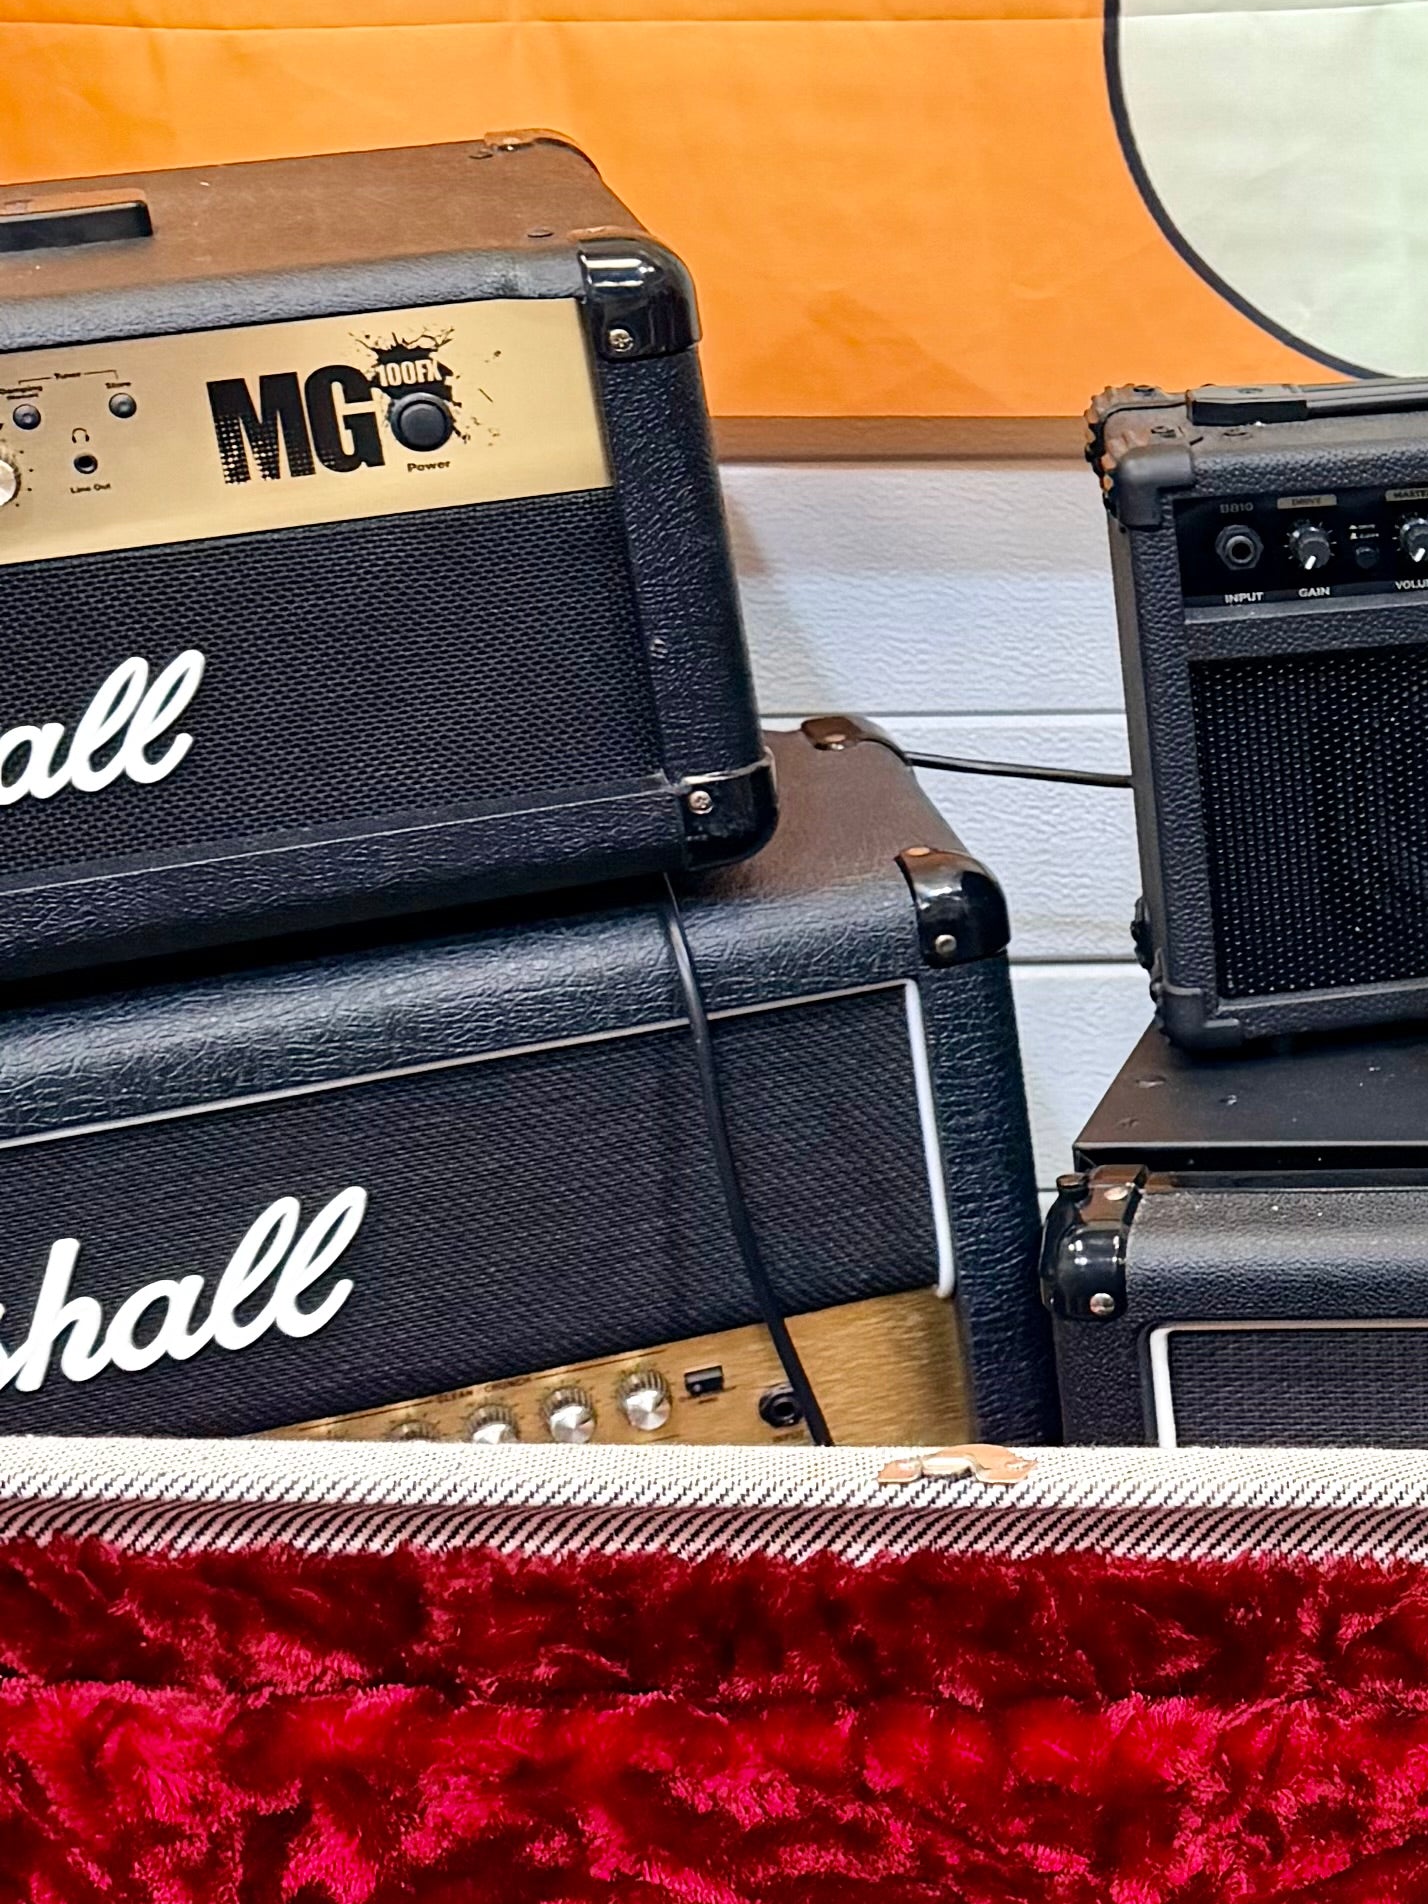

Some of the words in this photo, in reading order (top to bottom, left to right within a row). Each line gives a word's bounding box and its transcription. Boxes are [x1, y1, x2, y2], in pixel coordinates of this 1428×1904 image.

[376, 358, 442, 388] 100FX
[206, 364, 386, 485] MG
[407, 460, 451, 473] Power
[1224, 592, 1264, 604] INPUT
[1299, 586, 1331, 597] GAIN
